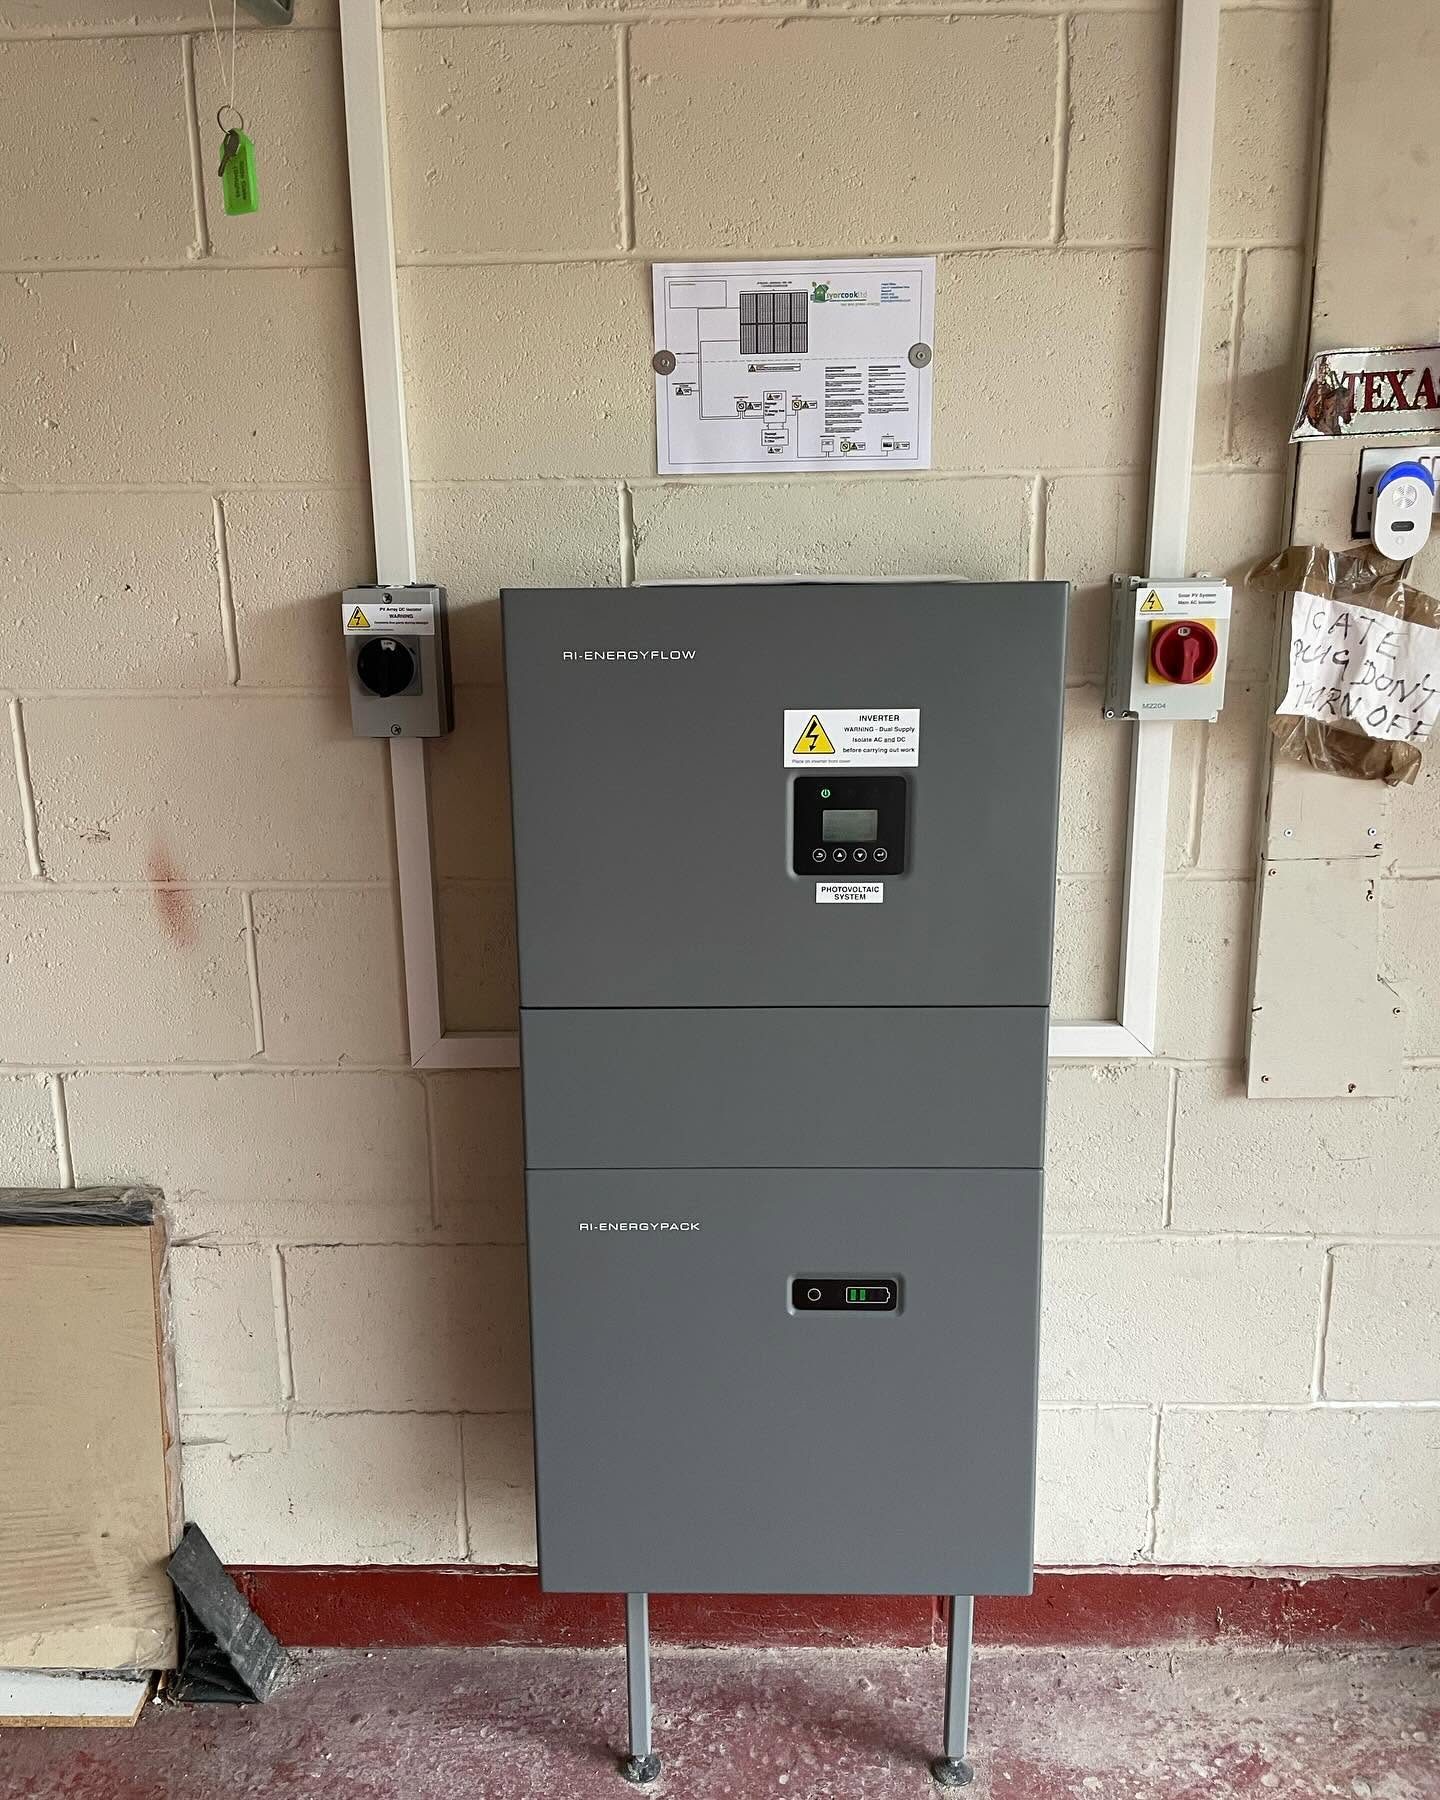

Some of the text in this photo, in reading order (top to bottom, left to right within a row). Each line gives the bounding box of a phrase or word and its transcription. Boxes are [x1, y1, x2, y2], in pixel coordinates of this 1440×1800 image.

[1341, 367, 1440, 414] TEXA
[563, 650, 696, 660] RI-ENERGYFLOW
[579, 1222, 700, 1231] RI-ENERGYPACK
